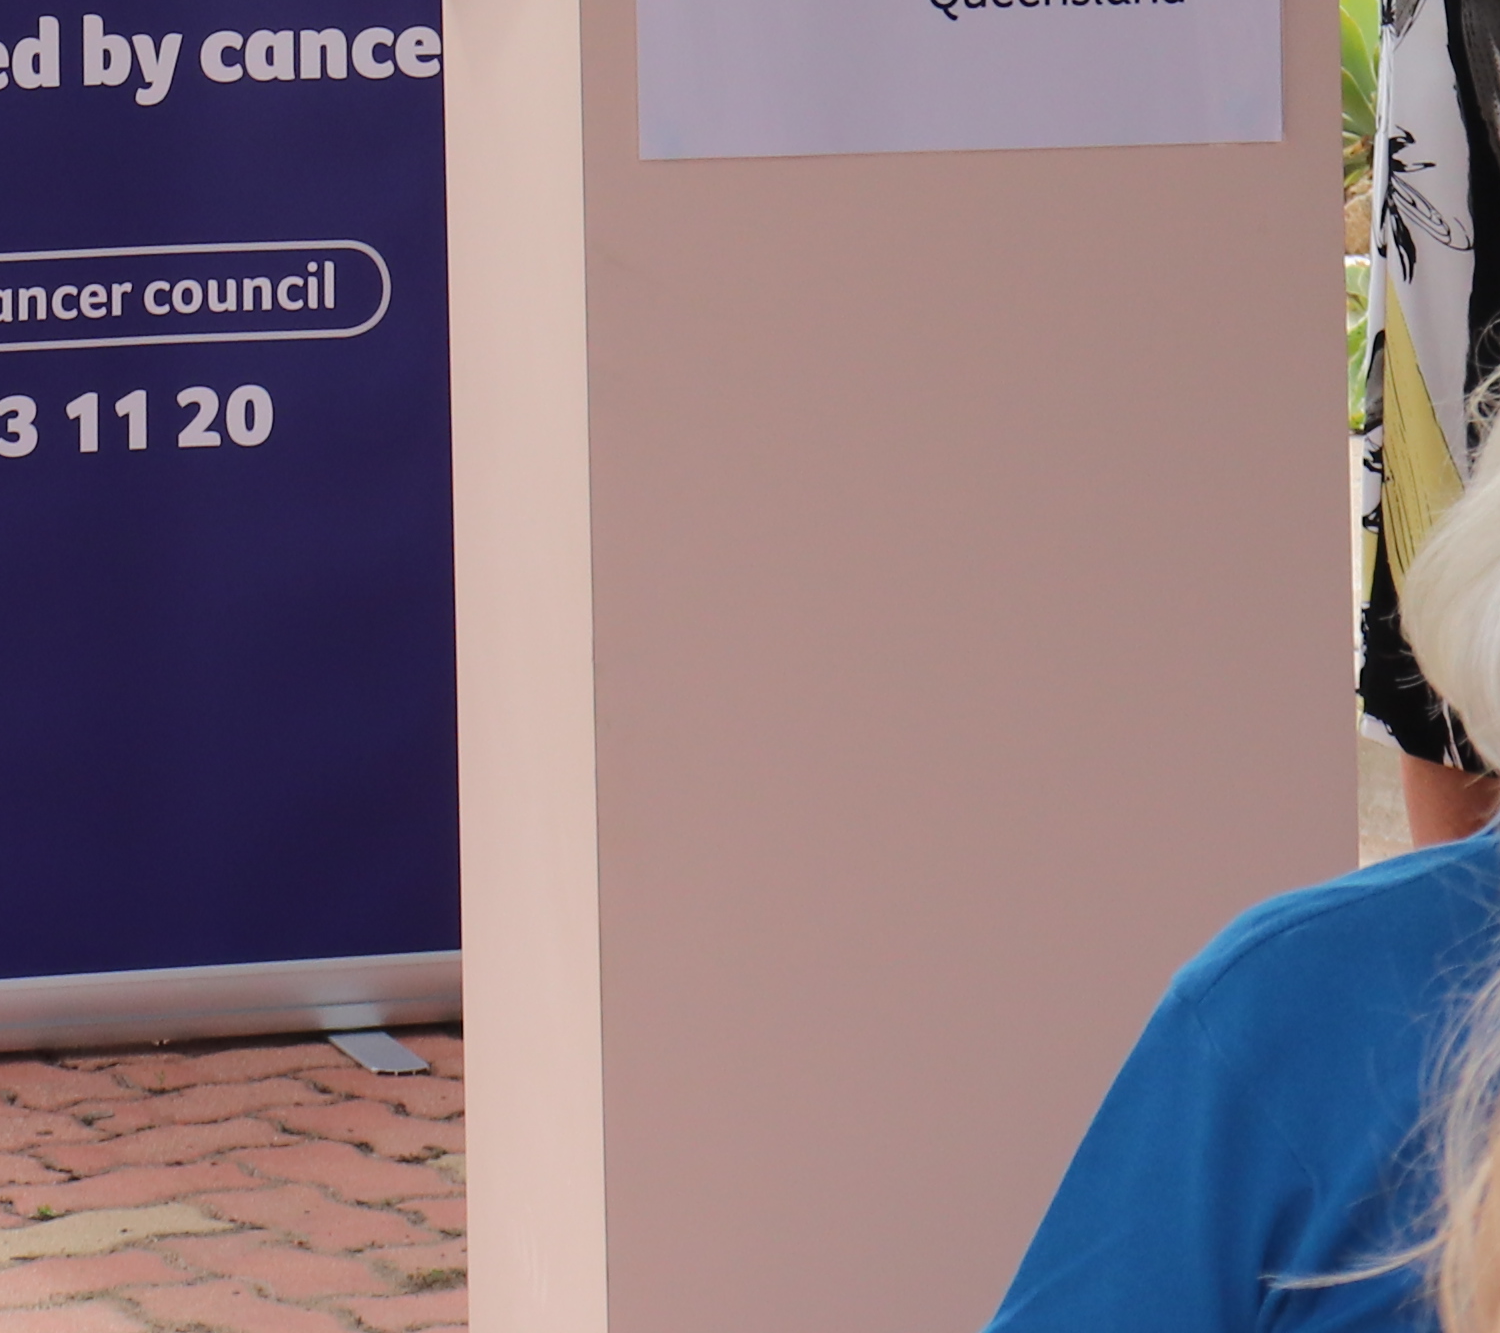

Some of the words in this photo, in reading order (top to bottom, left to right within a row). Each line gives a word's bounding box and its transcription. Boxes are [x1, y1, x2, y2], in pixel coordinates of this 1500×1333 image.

[82, 13, 183, 106] by
[200, 26, 442, 83] cance
[143, 260, 336, 315] council
[65, 389, 150, 453] 11
[176, 384, 274, 448] 20
